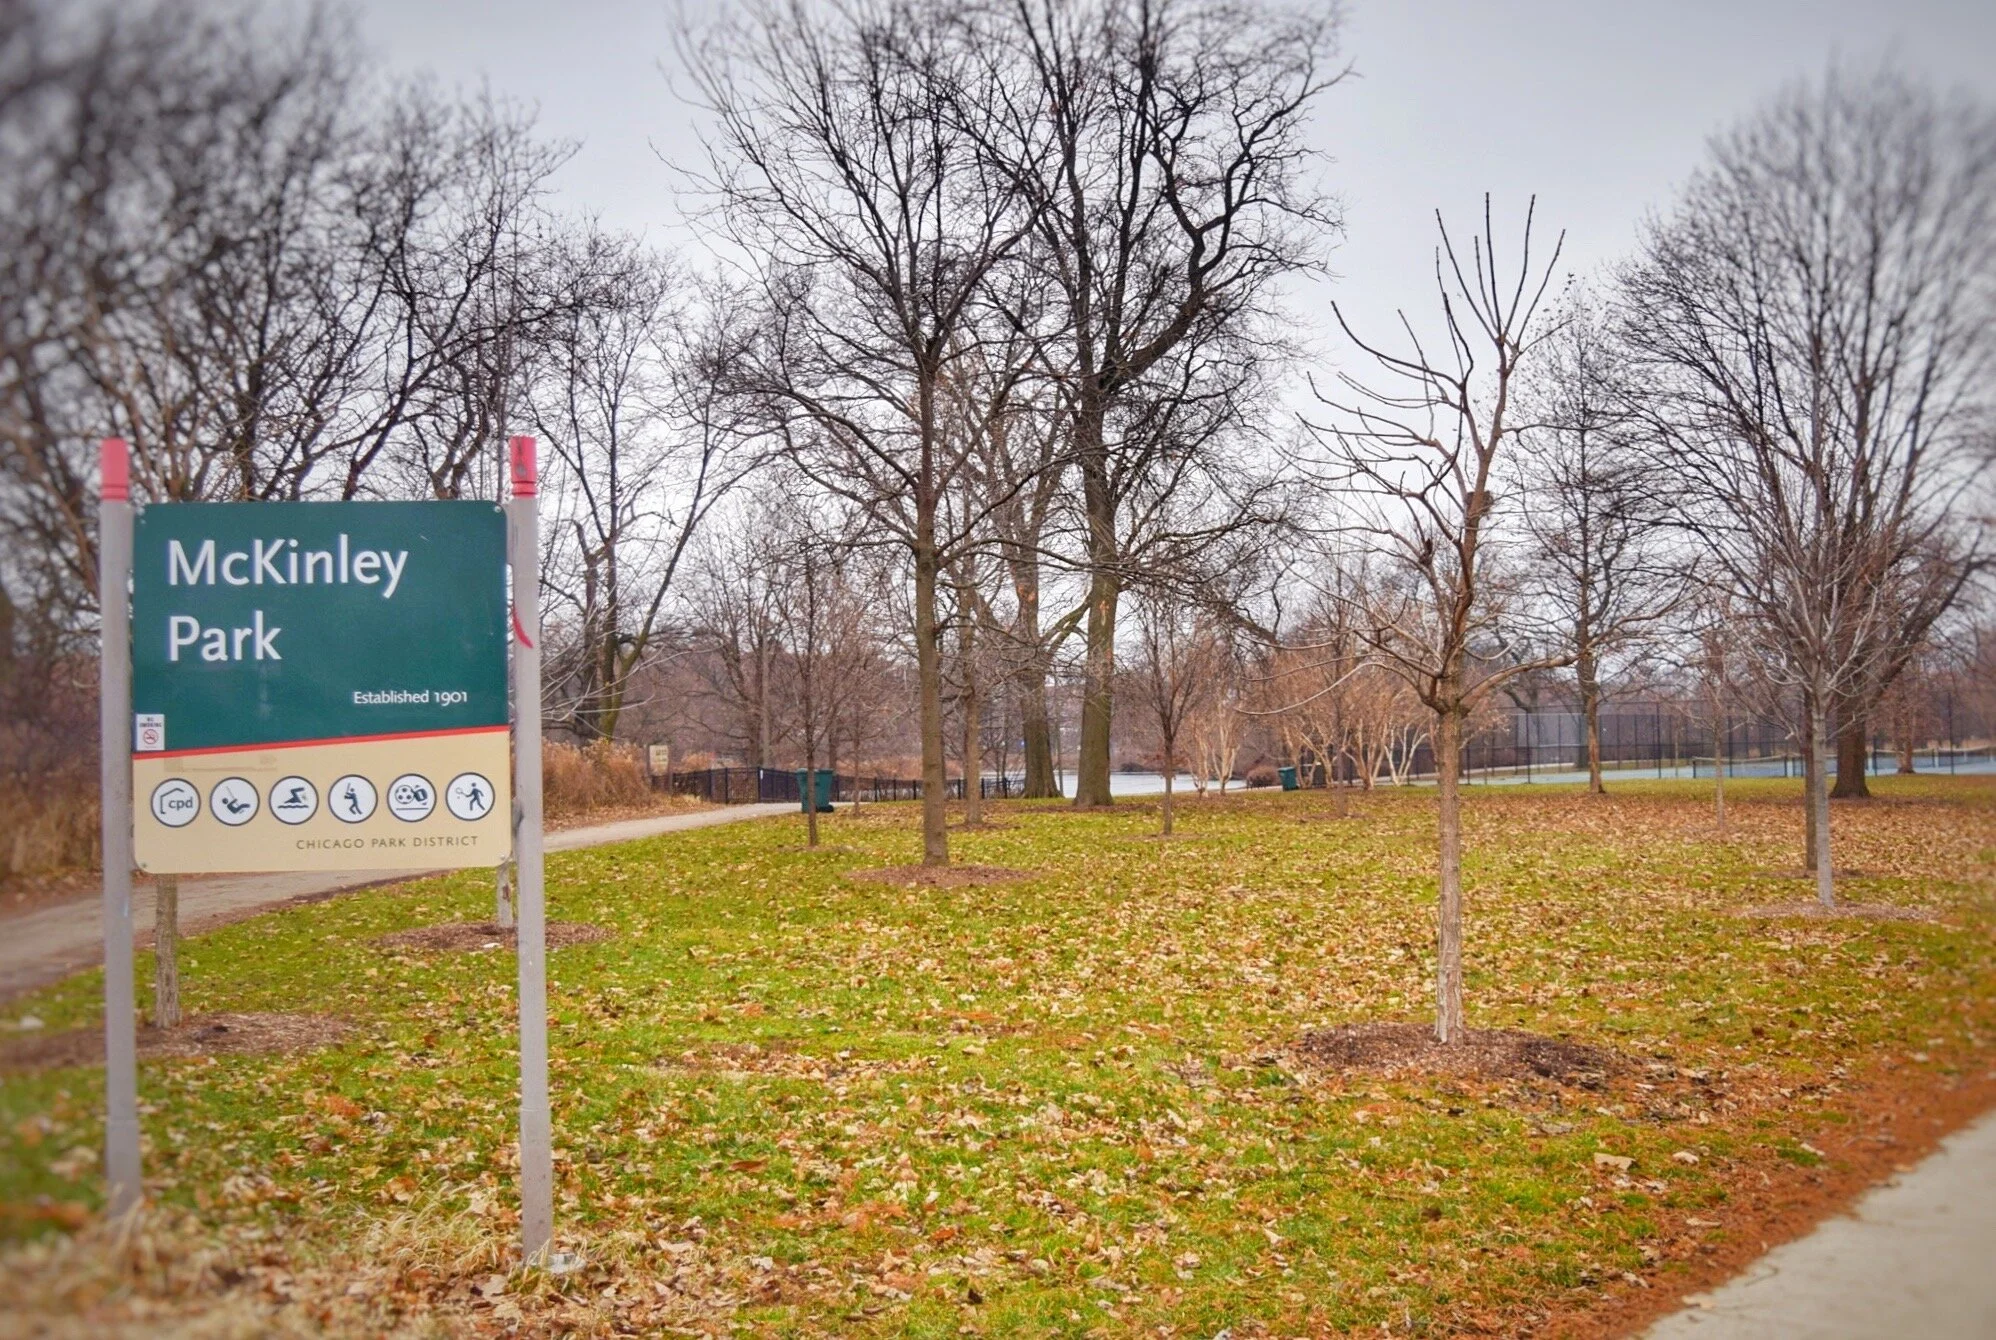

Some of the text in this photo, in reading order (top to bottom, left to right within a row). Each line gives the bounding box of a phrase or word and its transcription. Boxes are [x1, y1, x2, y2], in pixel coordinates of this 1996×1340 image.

[168, 534, 409, 598] McKinley
[168, 610, 283, 661] Park
[353, 690, 468, 707] Established 1901
[168, 796, 193, 810] cpd
[296, 835, 478, 850] CHICAGO PARK DISTRICT
